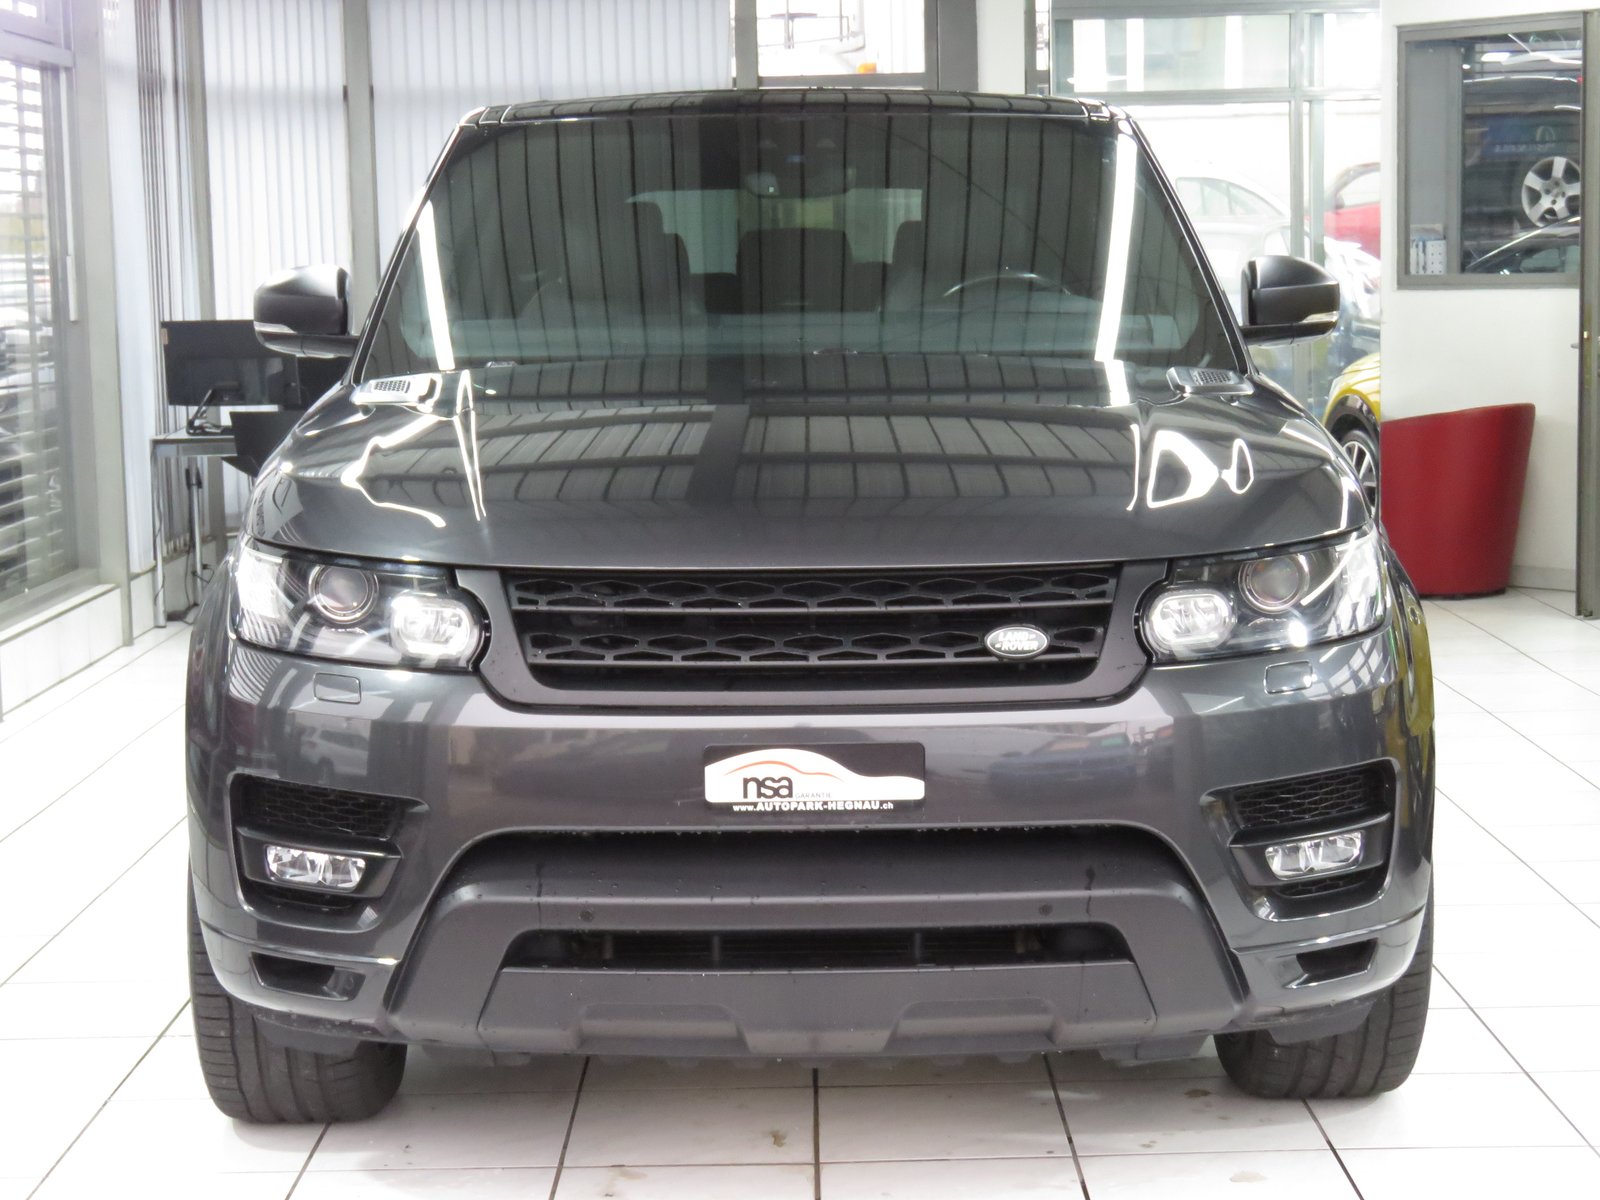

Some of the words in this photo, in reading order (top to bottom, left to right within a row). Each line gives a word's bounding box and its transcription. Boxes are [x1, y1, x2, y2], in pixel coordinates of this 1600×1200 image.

[998, 631, 1029, 641] LAND
[1001, 640, 1039, 651] ROVER
[743, 776, 793, 799] nsa
[732, 801, 894, 811] www.AUTOPARK-HEGNAU.ch
